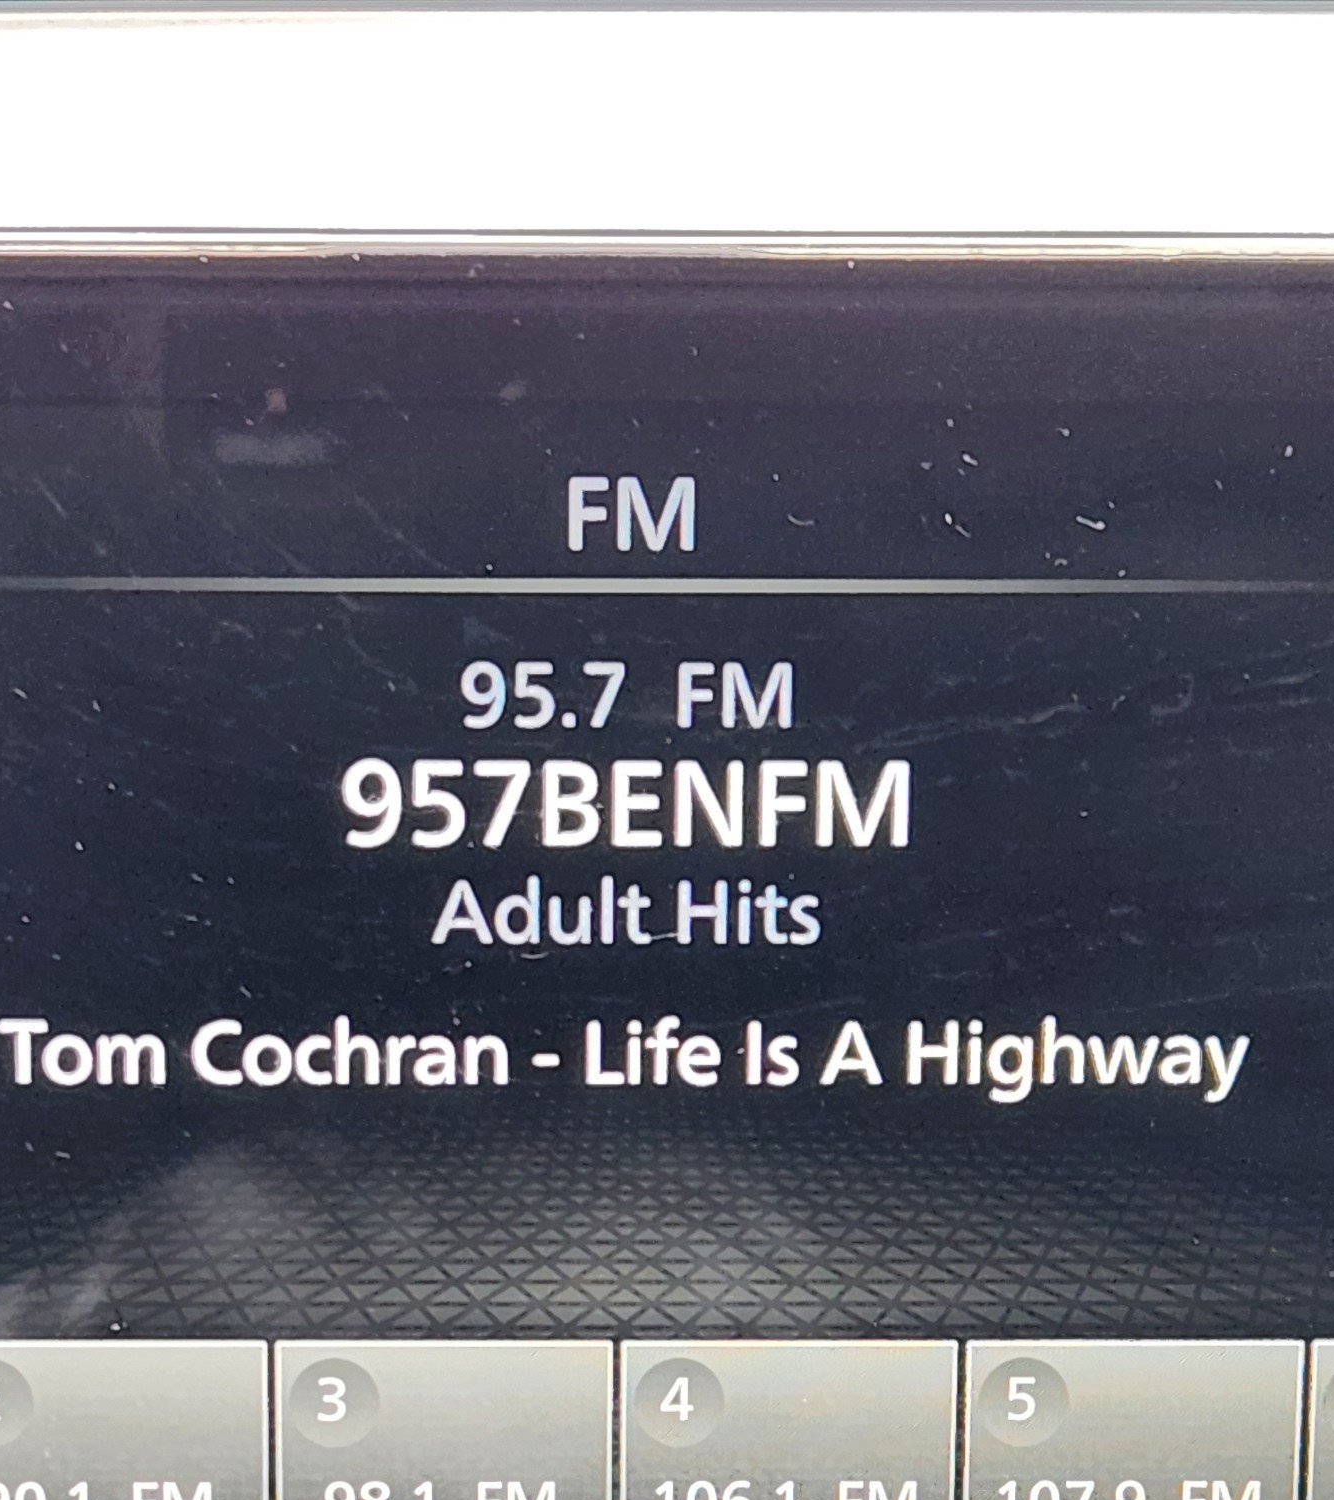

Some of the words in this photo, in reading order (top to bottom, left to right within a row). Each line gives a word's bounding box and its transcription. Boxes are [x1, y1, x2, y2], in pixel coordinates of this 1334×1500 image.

[567, 475, 697, 553] FM
[459, 660, 627, 731] 95.7
[676, 660, 794, 731] FM
[339, 756, 912, 850] 957BENFM
[431, 875, 652, 946] Adult
[674, 878, 822, 947] Hits
[189, 1013, 510, 1088] Cochran
[584, 1014, 723, 1089] Life
[744, 1019, 801, 1088] Is
[818, 1019, 885, 1087] A
[905, 1014, 1251, 1105] Highway
[315, 1375, 348, 1423] 3
[658, 1375, 696, 1423] 4
[1006, 1375, 1037, 1423] 5
